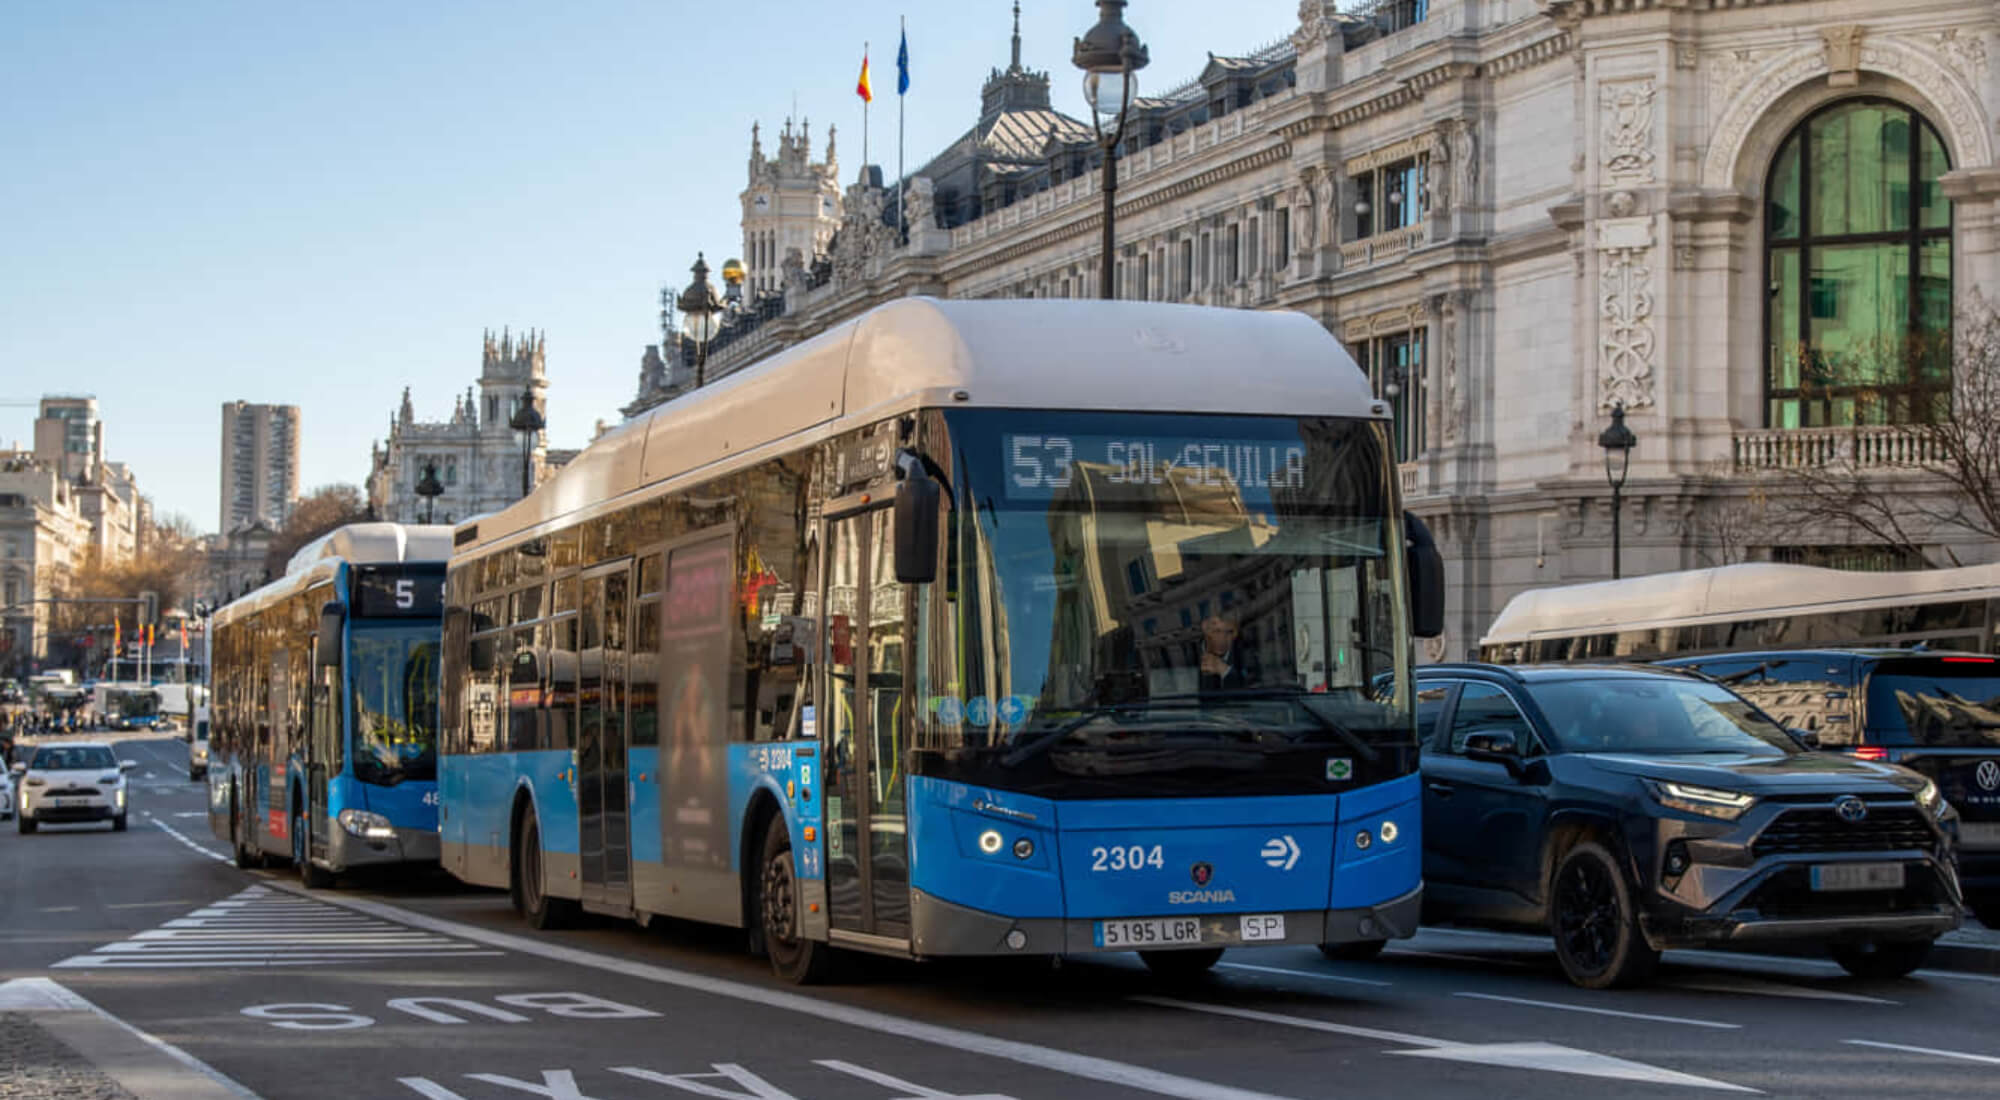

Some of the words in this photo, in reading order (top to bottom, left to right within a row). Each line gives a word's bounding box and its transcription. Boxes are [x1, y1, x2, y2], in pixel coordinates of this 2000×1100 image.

[1012, 436, 1073, 488] 53
[396, 580, 414, 608] 5
[1092, 845, 1164, 871] 2304
[1168, 889, 1236, 905] SCANIA
[1106, 922, 1156, 943] 5195
[1161, 920, 1199, 941] LGR
[1246, 917, 1278, 938] SP
[240, 992, 664, 1031] BUS
